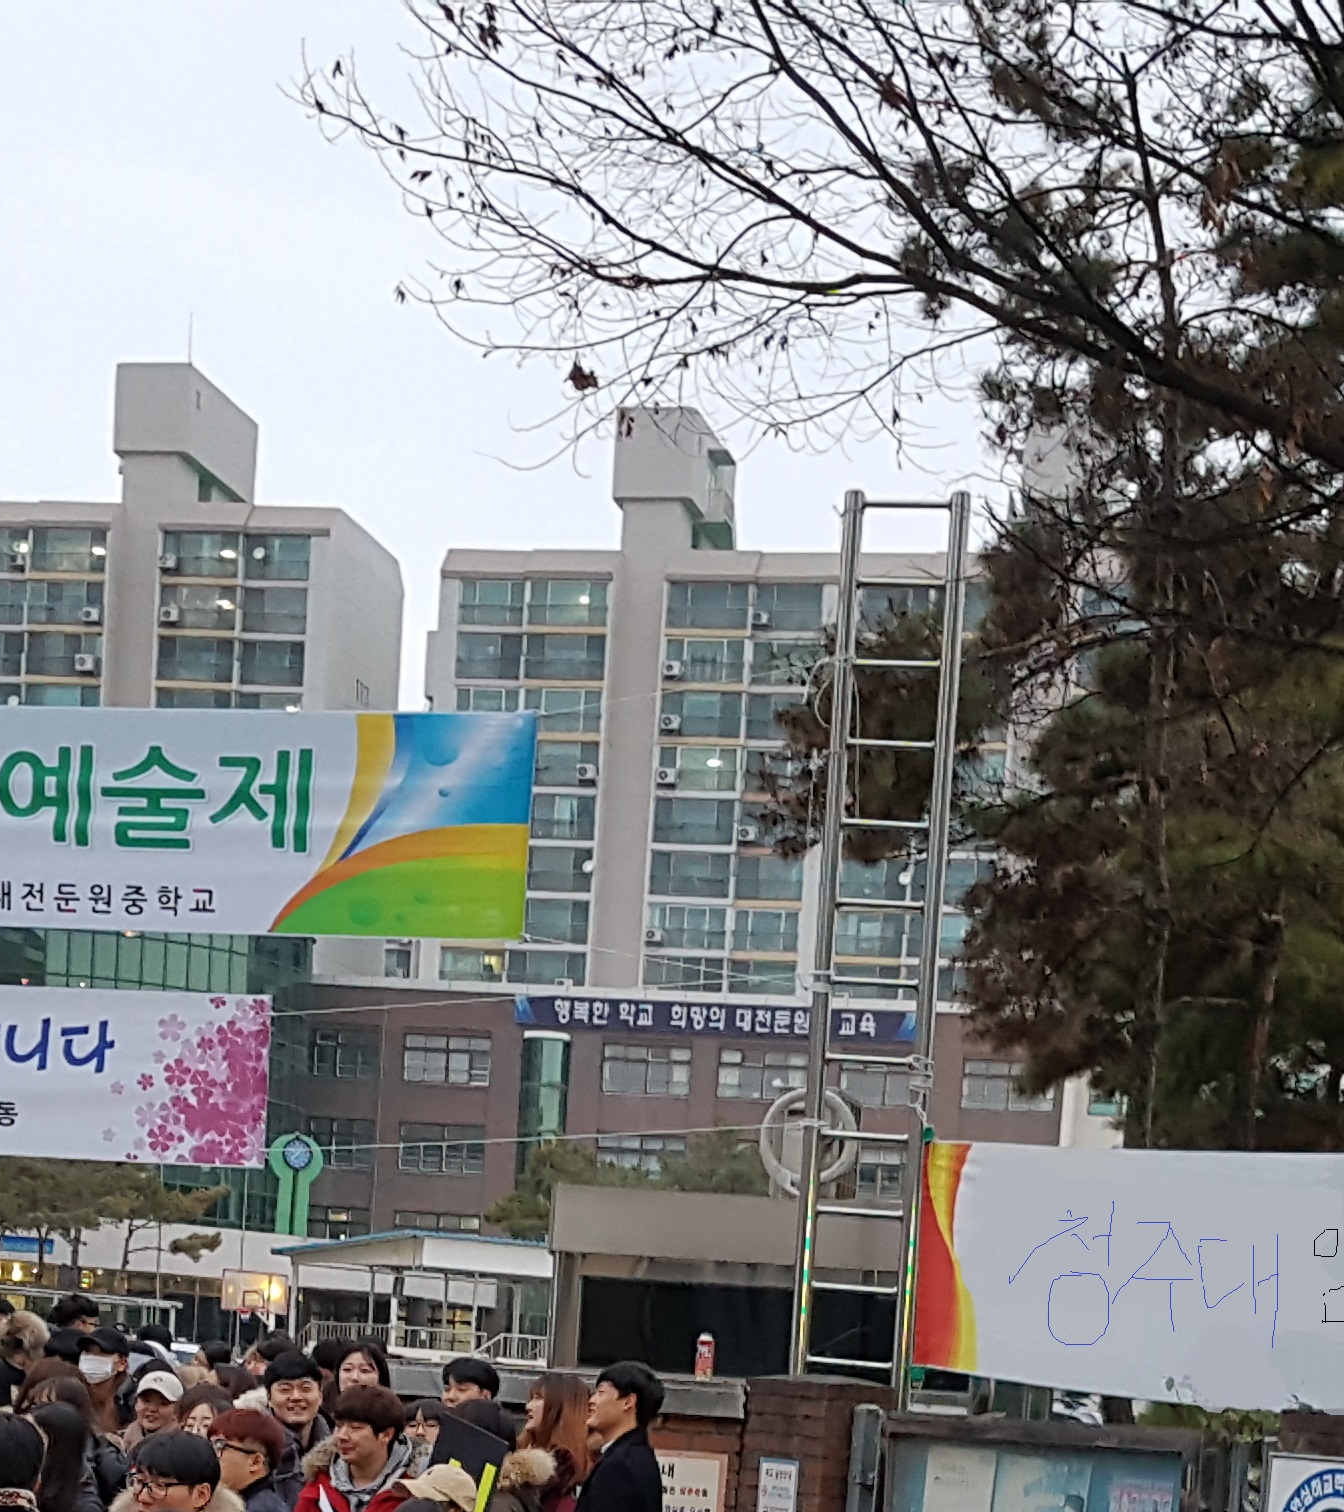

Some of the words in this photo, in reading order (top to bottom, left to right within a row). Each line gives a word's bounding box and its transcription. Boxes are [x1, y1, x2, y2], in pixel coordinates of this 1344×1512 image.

[553, 998, 609, 1025] 행복한
[619, 1002, 654, 1027] 학교
[669, 1004, 725, 1031] 희망의
[839, 1012, 877, 1038] 교육
